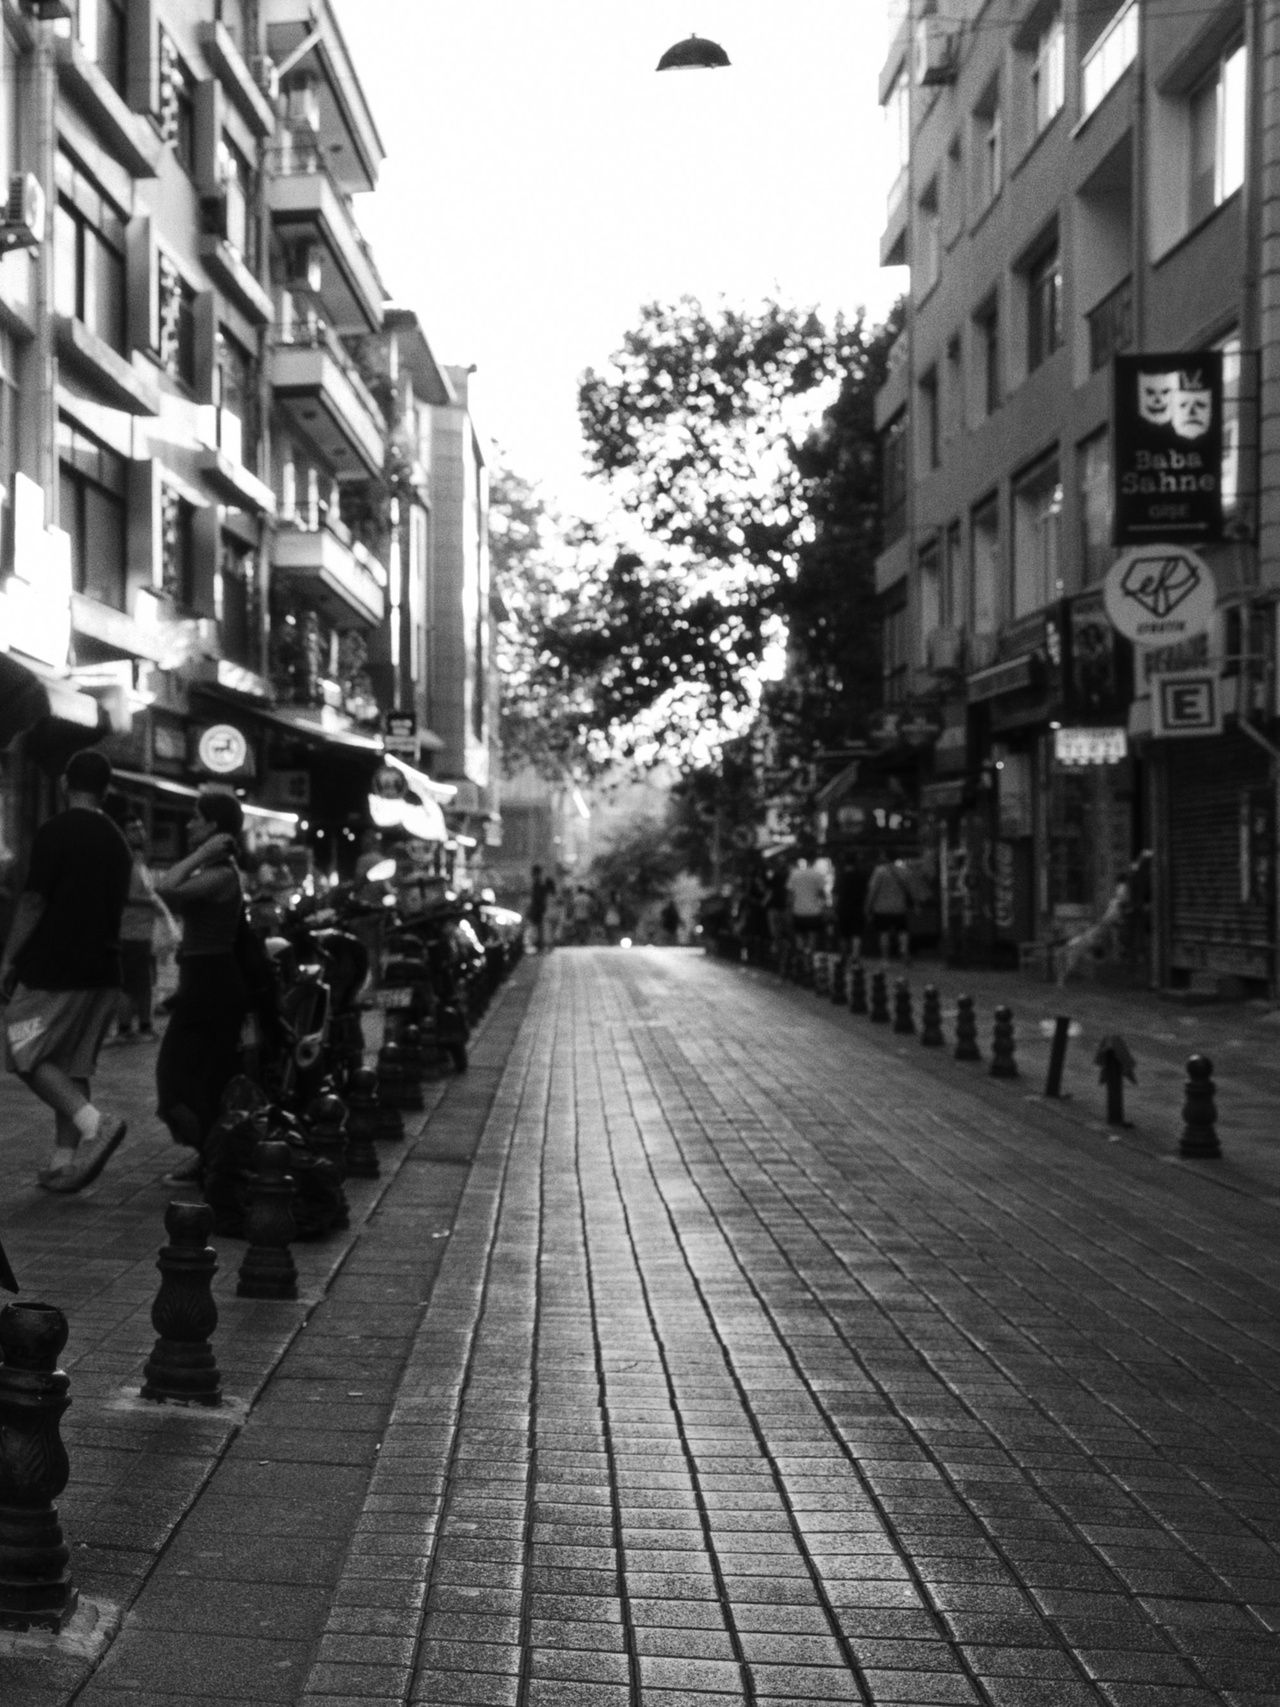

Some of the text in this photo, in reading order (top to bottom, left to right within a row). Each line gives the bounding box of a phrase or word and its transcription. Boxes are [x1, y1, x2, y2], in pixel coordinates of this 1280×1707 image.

[1135, 448, 1203, 471] Baba
[1121, 470, 1216, 495] Sahne
[1173, 688, 1203, 721] E
